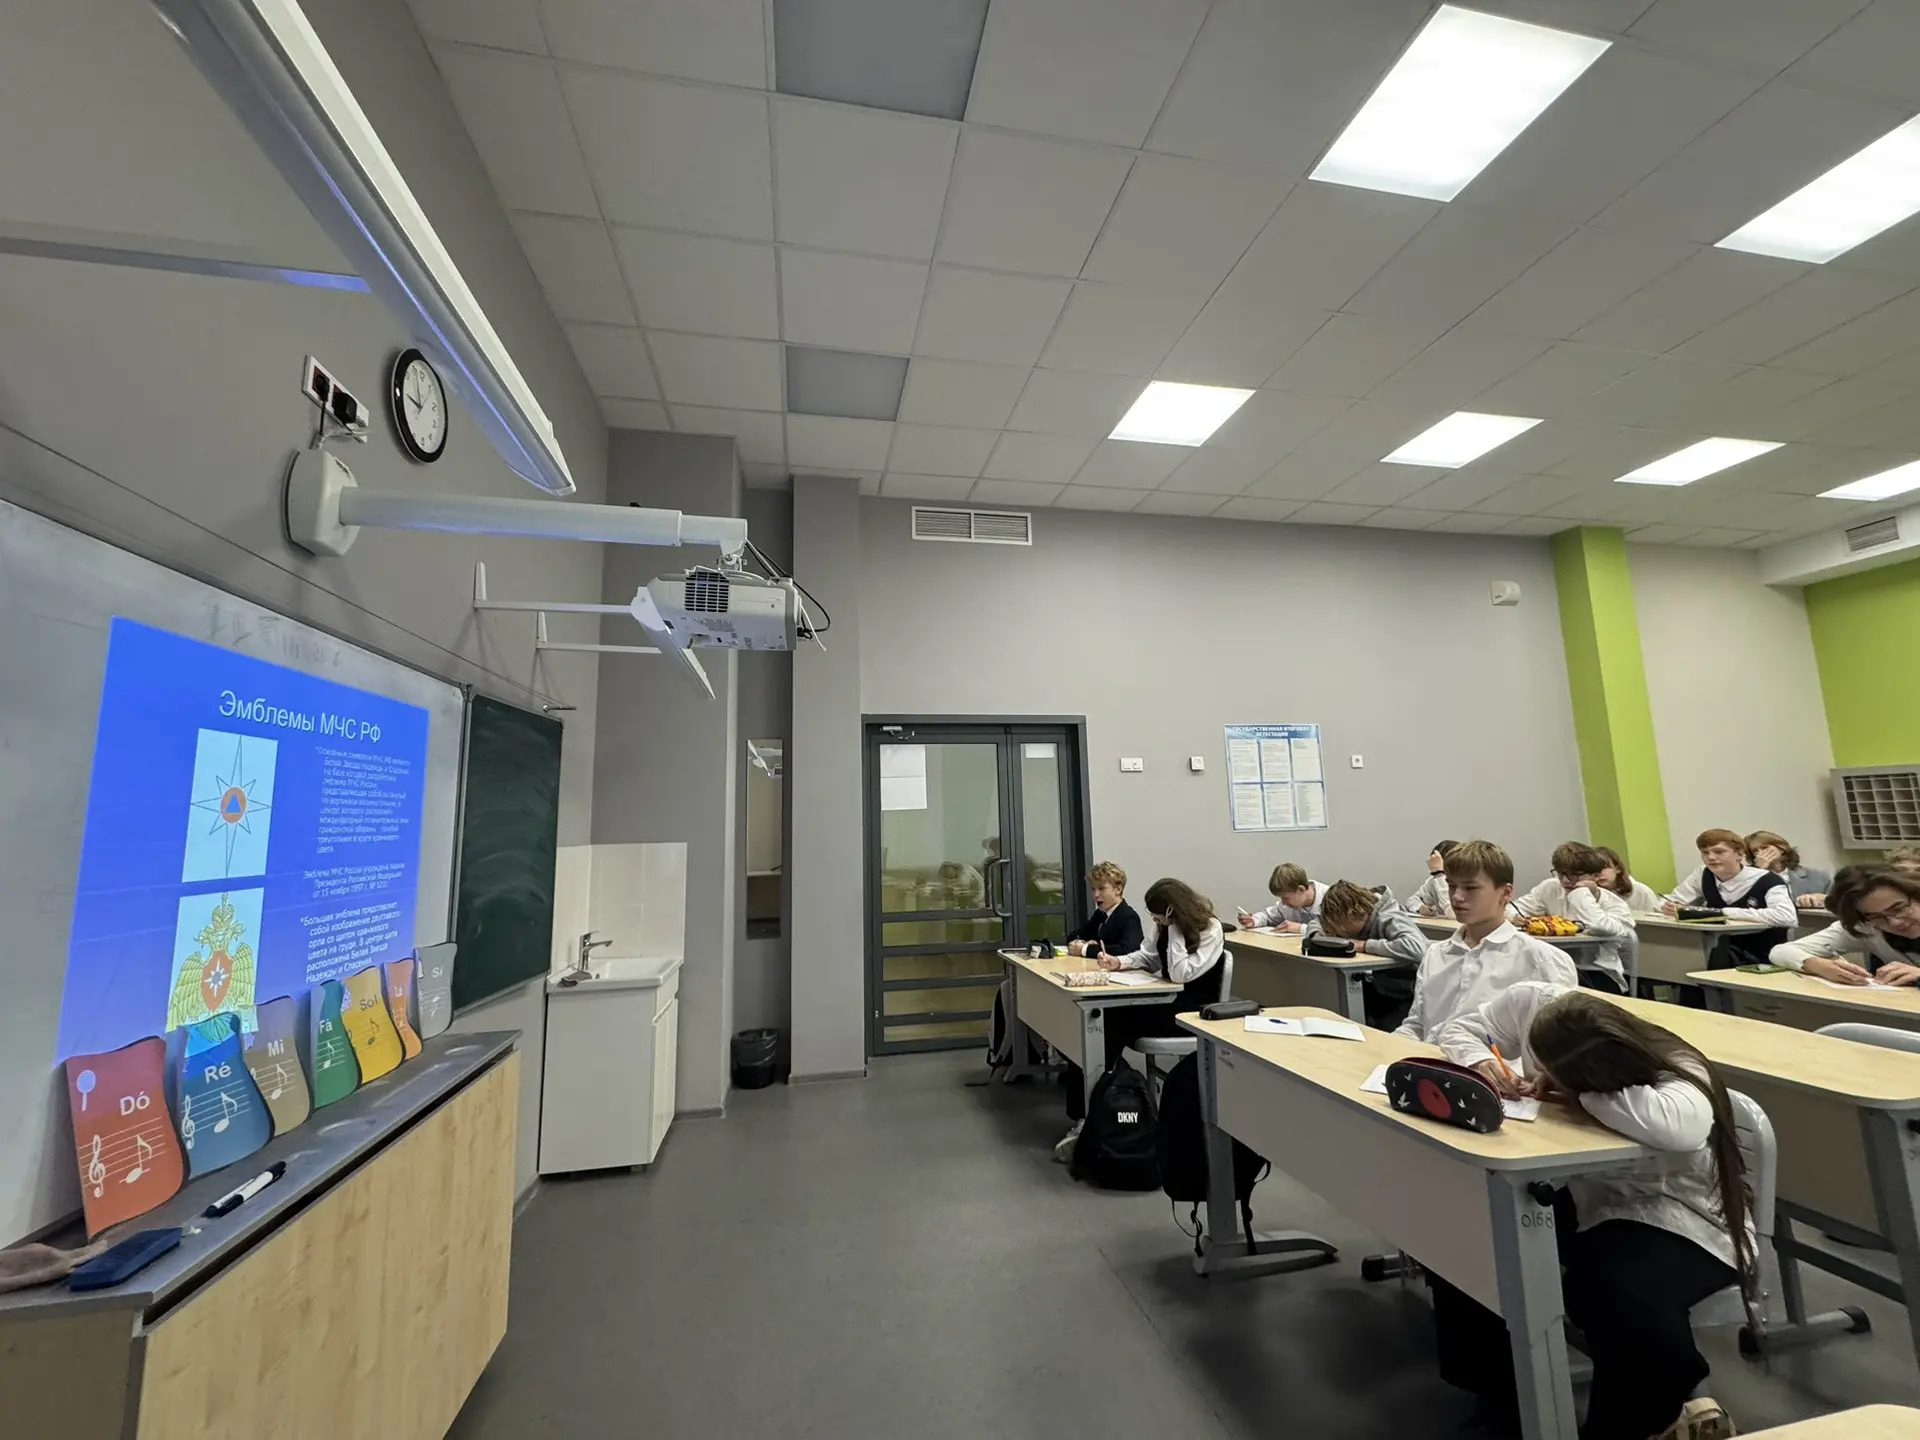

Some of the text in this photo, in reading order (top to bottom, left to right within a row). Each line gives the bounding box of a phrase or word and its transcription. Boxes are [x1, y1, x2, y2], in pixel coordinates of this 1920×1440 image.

[219, 689, 382, 744] Эмблемы МЧС РФ
[321, 887, 329, 897] 15
[307, 948, 328, 961] цвета
[328, 945, 338, 954] на
[305, 966, 337, 985] Надежды
[359, 993, 379, 1012] Sol
[267, 1039, 285, 1057] Mi
[204, 1062, 233, 1084] Ré
[119, 1090, 151, 1117] Dó
[1117, 1111, 1139, 1124] DKNY
[1520, 1210, 1554, 1230] 0168
